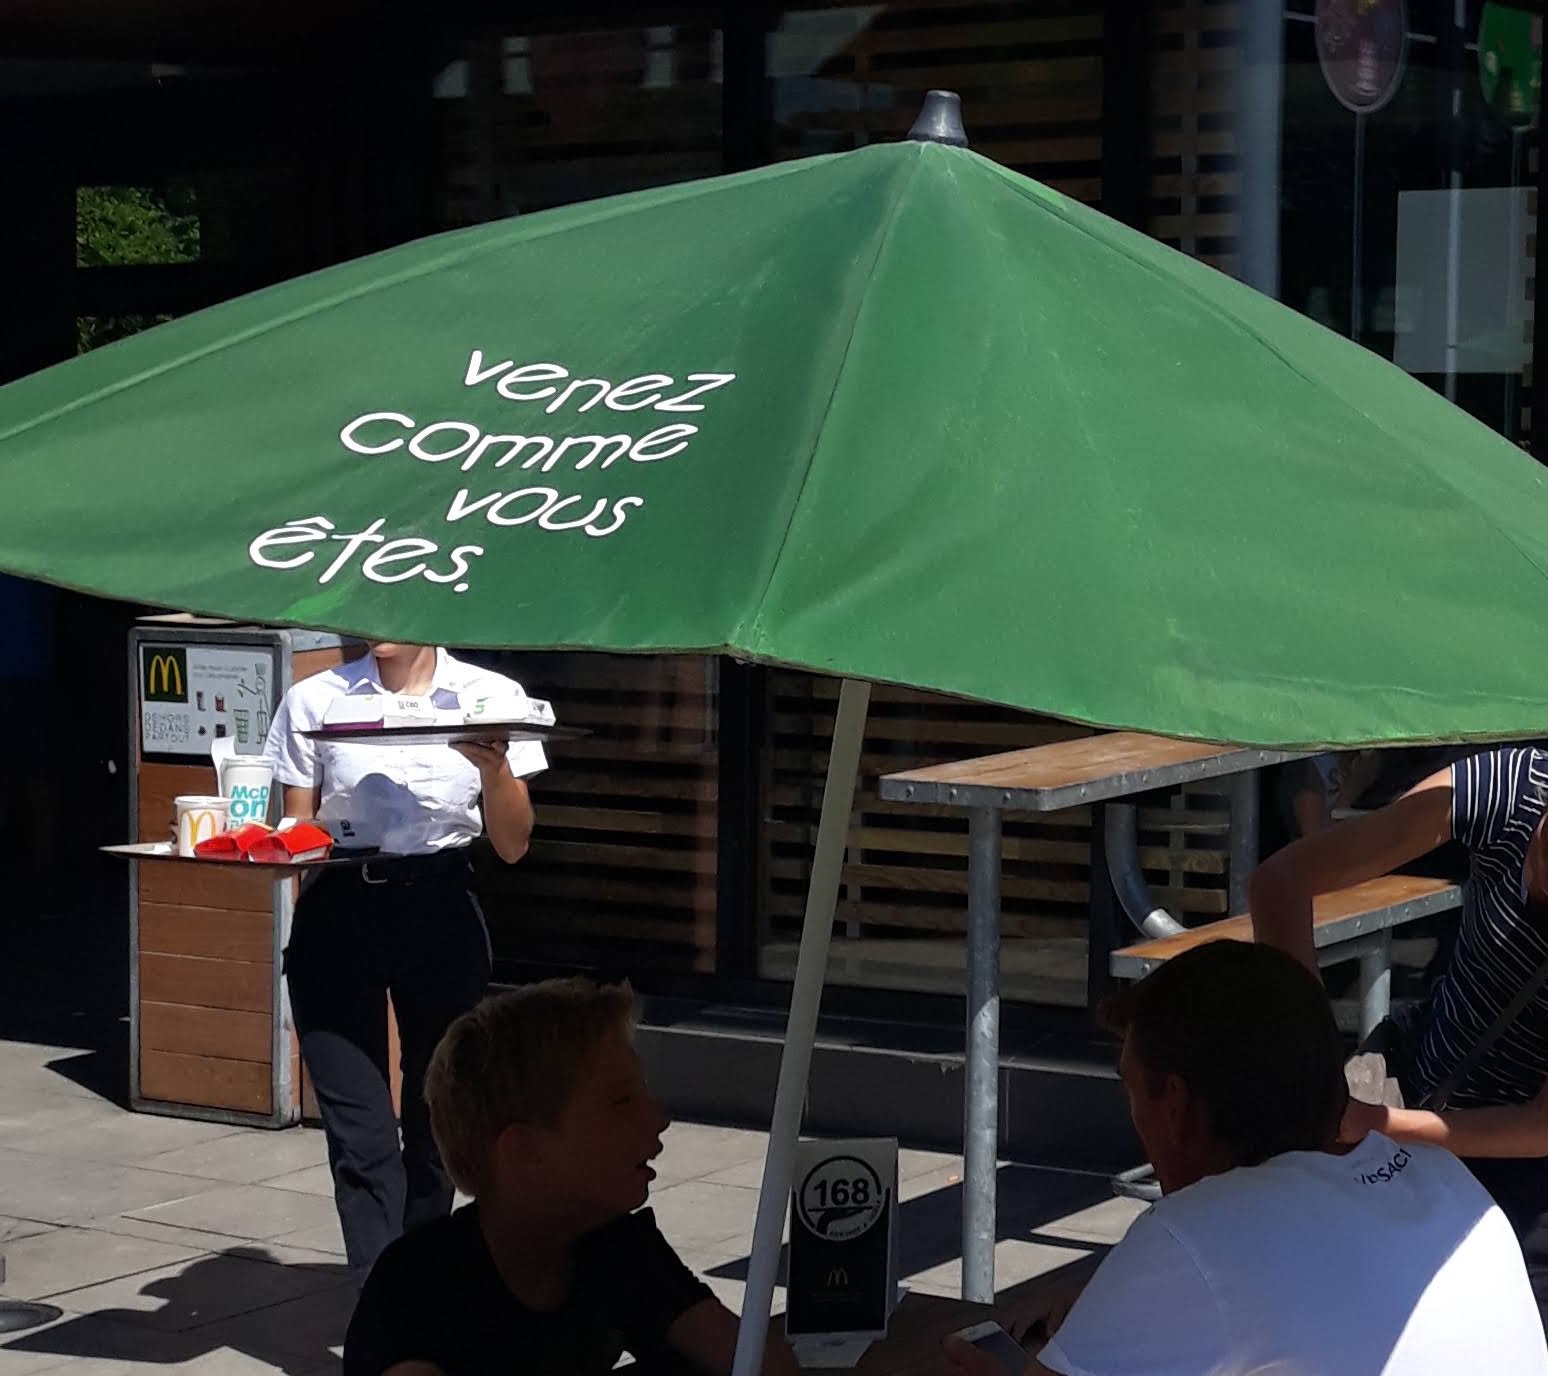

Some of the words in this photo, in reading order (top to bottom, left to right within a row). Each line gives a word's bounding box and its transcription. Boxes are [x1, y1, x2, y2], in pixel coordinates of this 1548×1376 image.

[464, 349, 737, 414] venez
[340, 411, 699, 472] comme
[446, 486, 644, 537] vous
[248, 516, 484, 593] êtes.
[144, 732, 190, 744] PARTOUT
[230, 784, 269, 799] McD
[230, 800, 267, 818] on
[813, 1178, 870, 1208] 168
